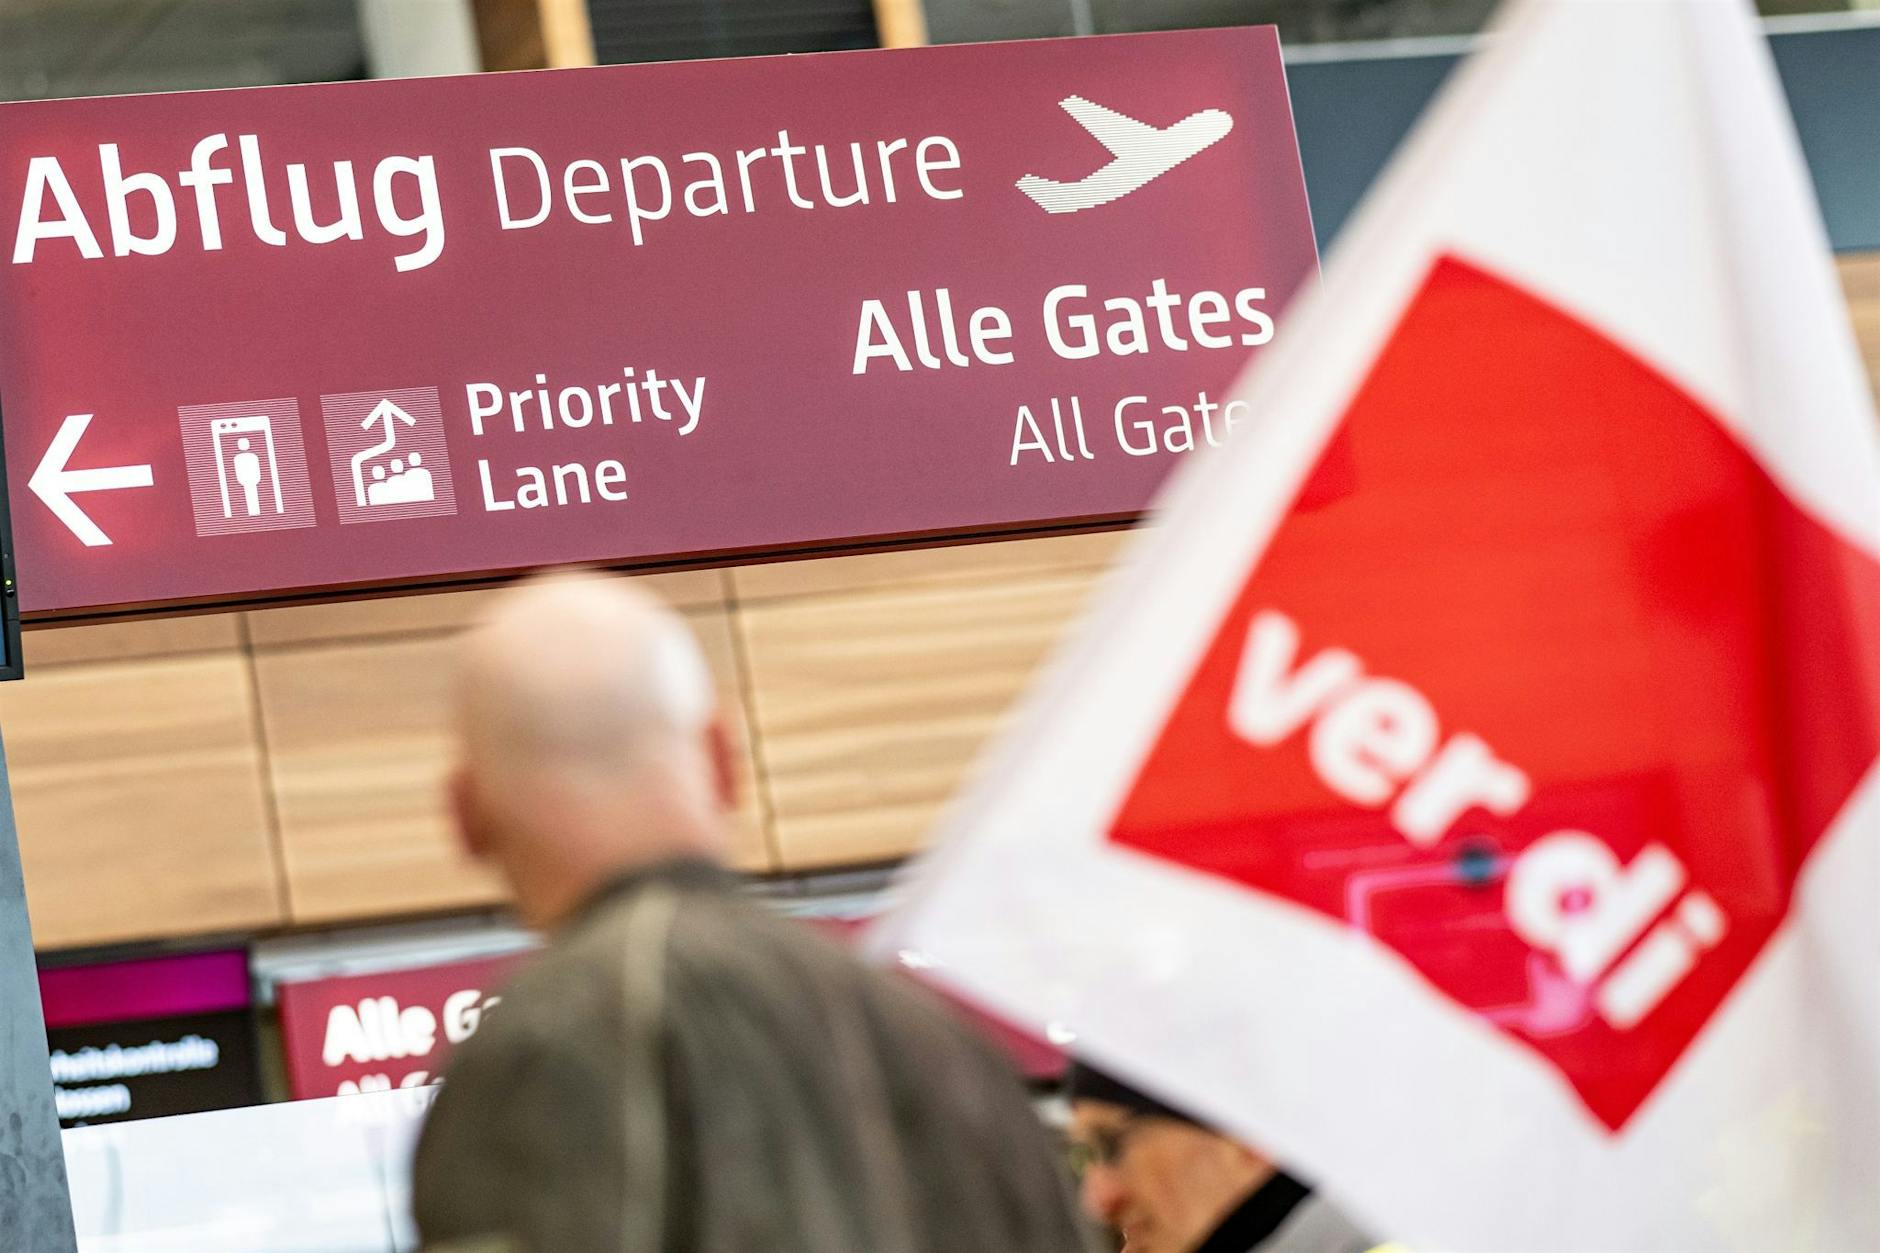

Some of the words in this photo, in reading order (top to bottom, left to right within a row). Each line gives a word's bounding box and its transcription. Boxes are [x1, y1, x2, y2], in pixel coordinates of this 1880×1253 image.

[12, 133, 445, 272] Abflug
[489, 130, 964, 246] Departure
[852, 287, 1015, 375] Alle
[1043, 279, 1275, 361] Gates
[465, 367, 706, 436] Priority
[1010, 396, 1094, 466] All
[1114, 391, 1250, 457] Gate
[478, 459, 628, 512] Lane
[322, 995, 437, 1067] Alle
